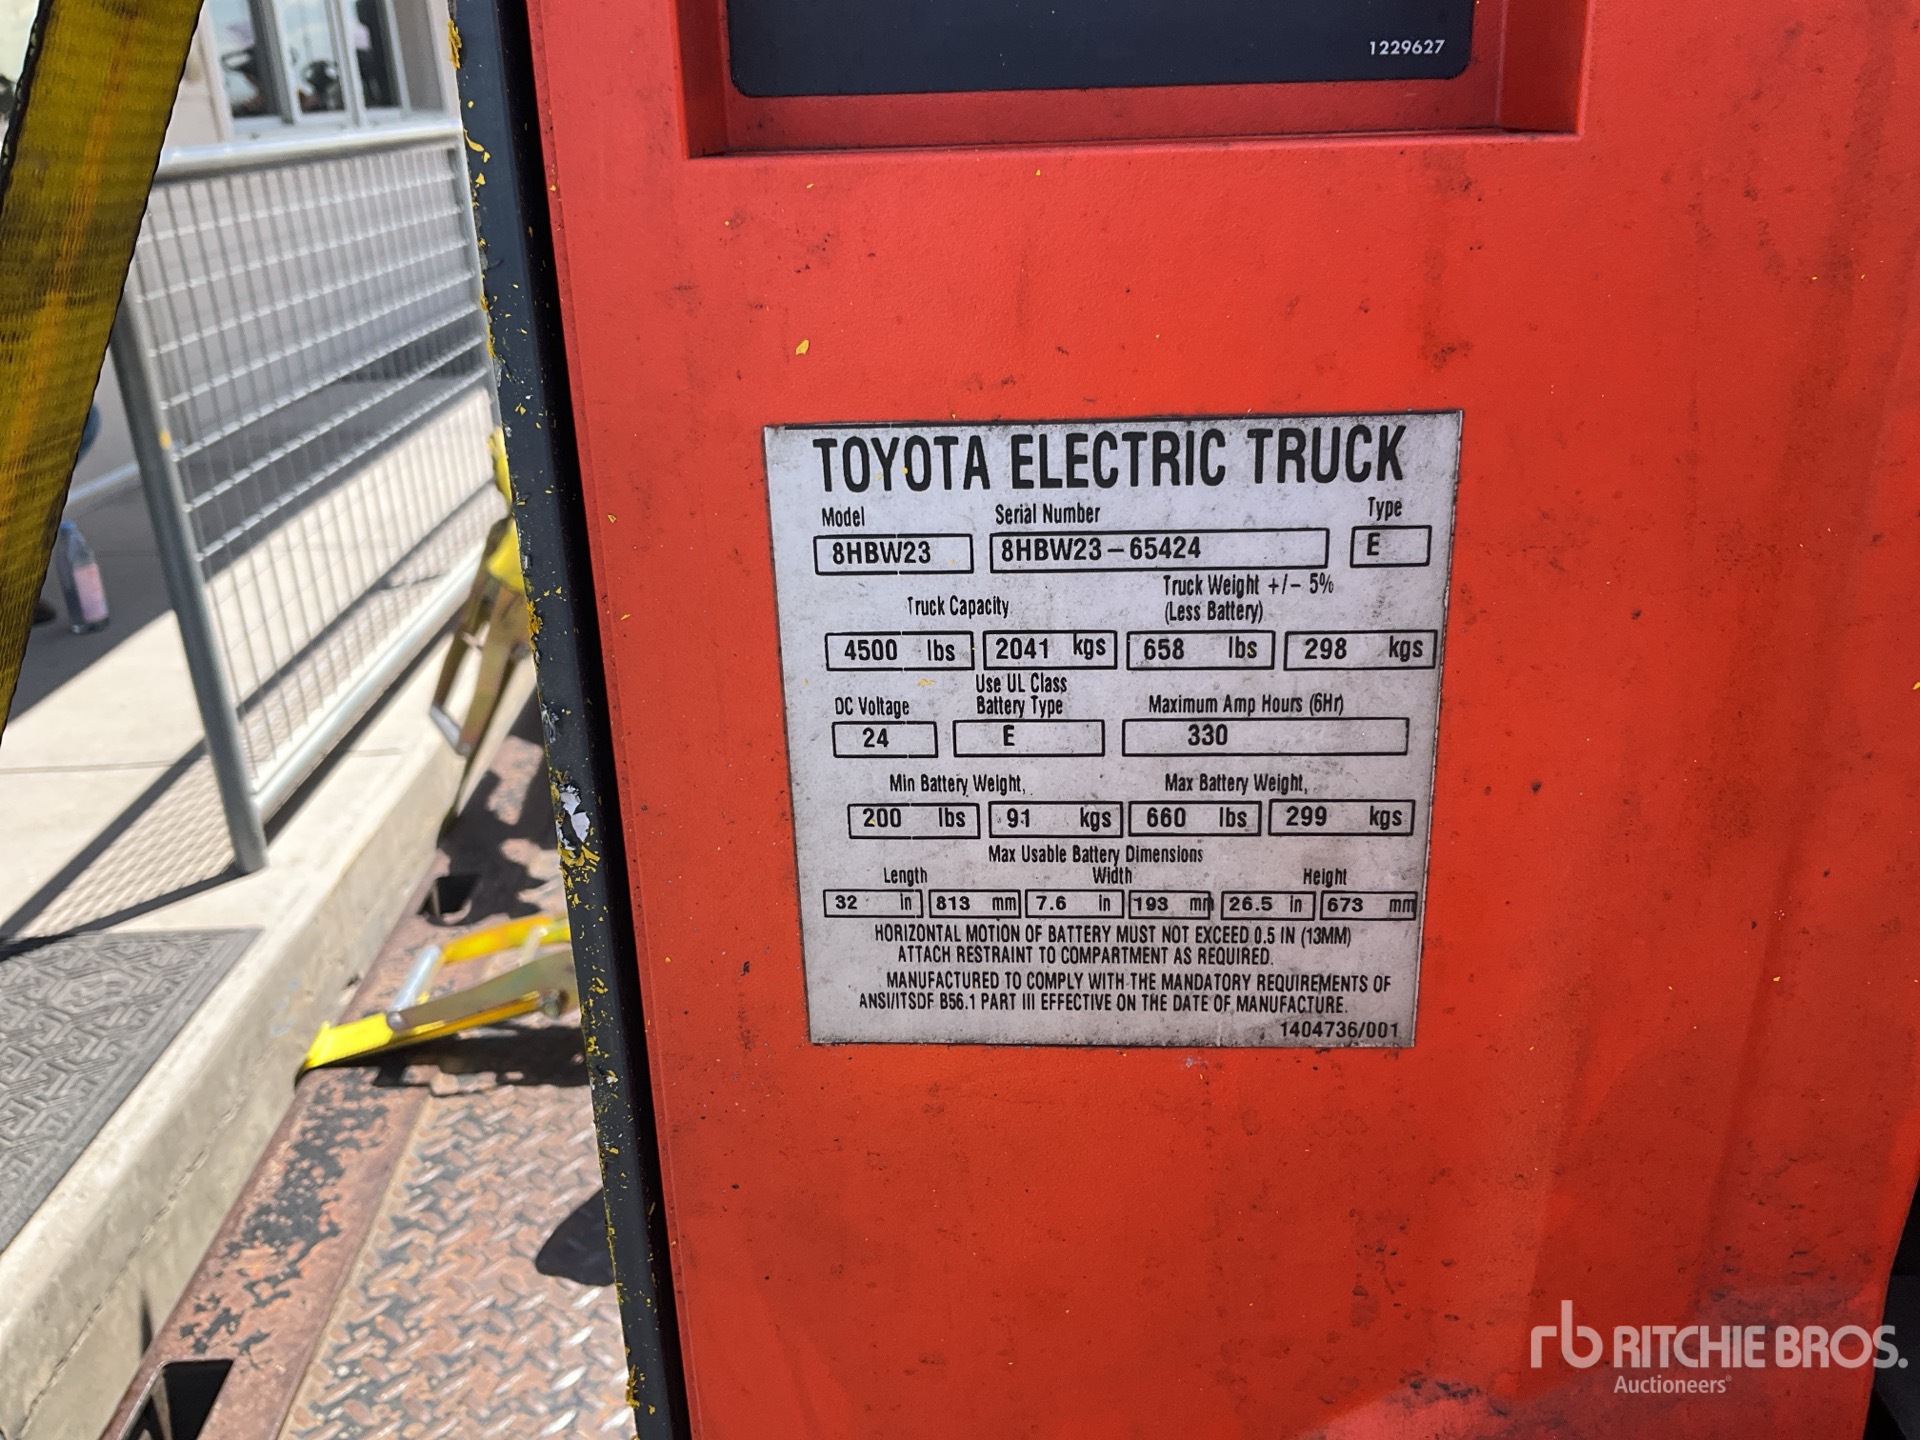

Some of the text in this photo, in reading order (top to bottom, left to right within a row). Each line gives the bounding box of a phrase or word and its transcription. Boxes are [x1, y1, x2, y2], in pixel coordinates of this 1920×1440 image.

[1369, 39, 1446, 56] 1229627
[812, 423, 1407, 493] TOYOTA ELECTRIC TRUCK
[821, 506, 866, 528] Model
[995, 501, 1101, 525] Serial Number
[1367, 495, 1403, 522] Type
[832, 540, 932, 566] 8HBW23
[1366, 532, 1381, 557] E
[1163, 573, 1203, 597] Truck
[1207, 574, 1260, 600] Weight
[1309, 571, 1335, 595] 5%
[907, 594, 1010, 620] Truck Capacity
[1164, 599, 1265, 625] (Less Battery)
[844, 638, 957, 662] 4500 lbs
[995, 631, 1107, 661] 2041 kgs
[1142, 635, 1259, 661] 658 lbs
[1304, 635, 1424, 663] 298 kgs
[975, 672, 1068, 694] Use UL Class
[834, 695, 910, 719] DC Voltage
[976, 694, 1064, 719] Battery Type
[1148, 692, 1345, 717] Maximum Amp Hours (6Hr)
[862, 727, 890, 749] 24
[1002, 724, 1016, 747] E
[1187, 723, 1229, 747] 330
[889, 773, 916, 793] Min
[920, 772, 970, 798] Battery
[1164, 773, 1194, 793] Max
[1199, 772, 1249, 796] Battery
[862, 807, 967, 829] 200 lbs
[1006, 806, 1112, 832] 91 kgs
[1146, 806, 1248, 829] 660 lbs
[1285, 805, 1404, 831] 299 kgs
[988, 844, 1205, 868] Max Usable Battery Dimensions
[883, 866, 928, 888] Length
[1092, 866, 1133, 885] Width
[1303, 867, 1348, 889] Height
[835, 892, 913, 912] 32 in
[935, 895, 1018, 912] 813 mm
[1035, 893, 1111, 912] 7.6 in
[1133, 895, 1215, 912] 193 mm
[1228, 894, 1303, 914] 26.5 in
[1326, 897, 1417, 914] 673 mm
[874, 923, 1352, 950] HORIZONTAL MOTION OF BATTERY MUST NOT EXCEED 0.5 IN (13MM)
[897, 944, 1275, 966] ATTACH RESTRAINT TO COMPARTMENT AS REQUIRED.
[886, 970, 1392, 993] MANUFACTURED TO COMPLY WITH THE MANDATORY REQUIREMENTS OF
[939, 992, 976, 1011] B56.1
[980, 993, 1017, 1011] PART
[1021, 993, 1036, 1011] III
[1040, 993, 1112, 1012] EFFECTIVE
[1116, 993, 1136, 1012] ON
[1141, 993, 1168, 1012] THE
[1172, 994, 1209, 1013] DATE
[1213, 994, 1231, 1013] OF
[1235, 995, 1349, 1014] MANUFACTURE.
[1280, 1020, 1399, 1039] 1404736/001
